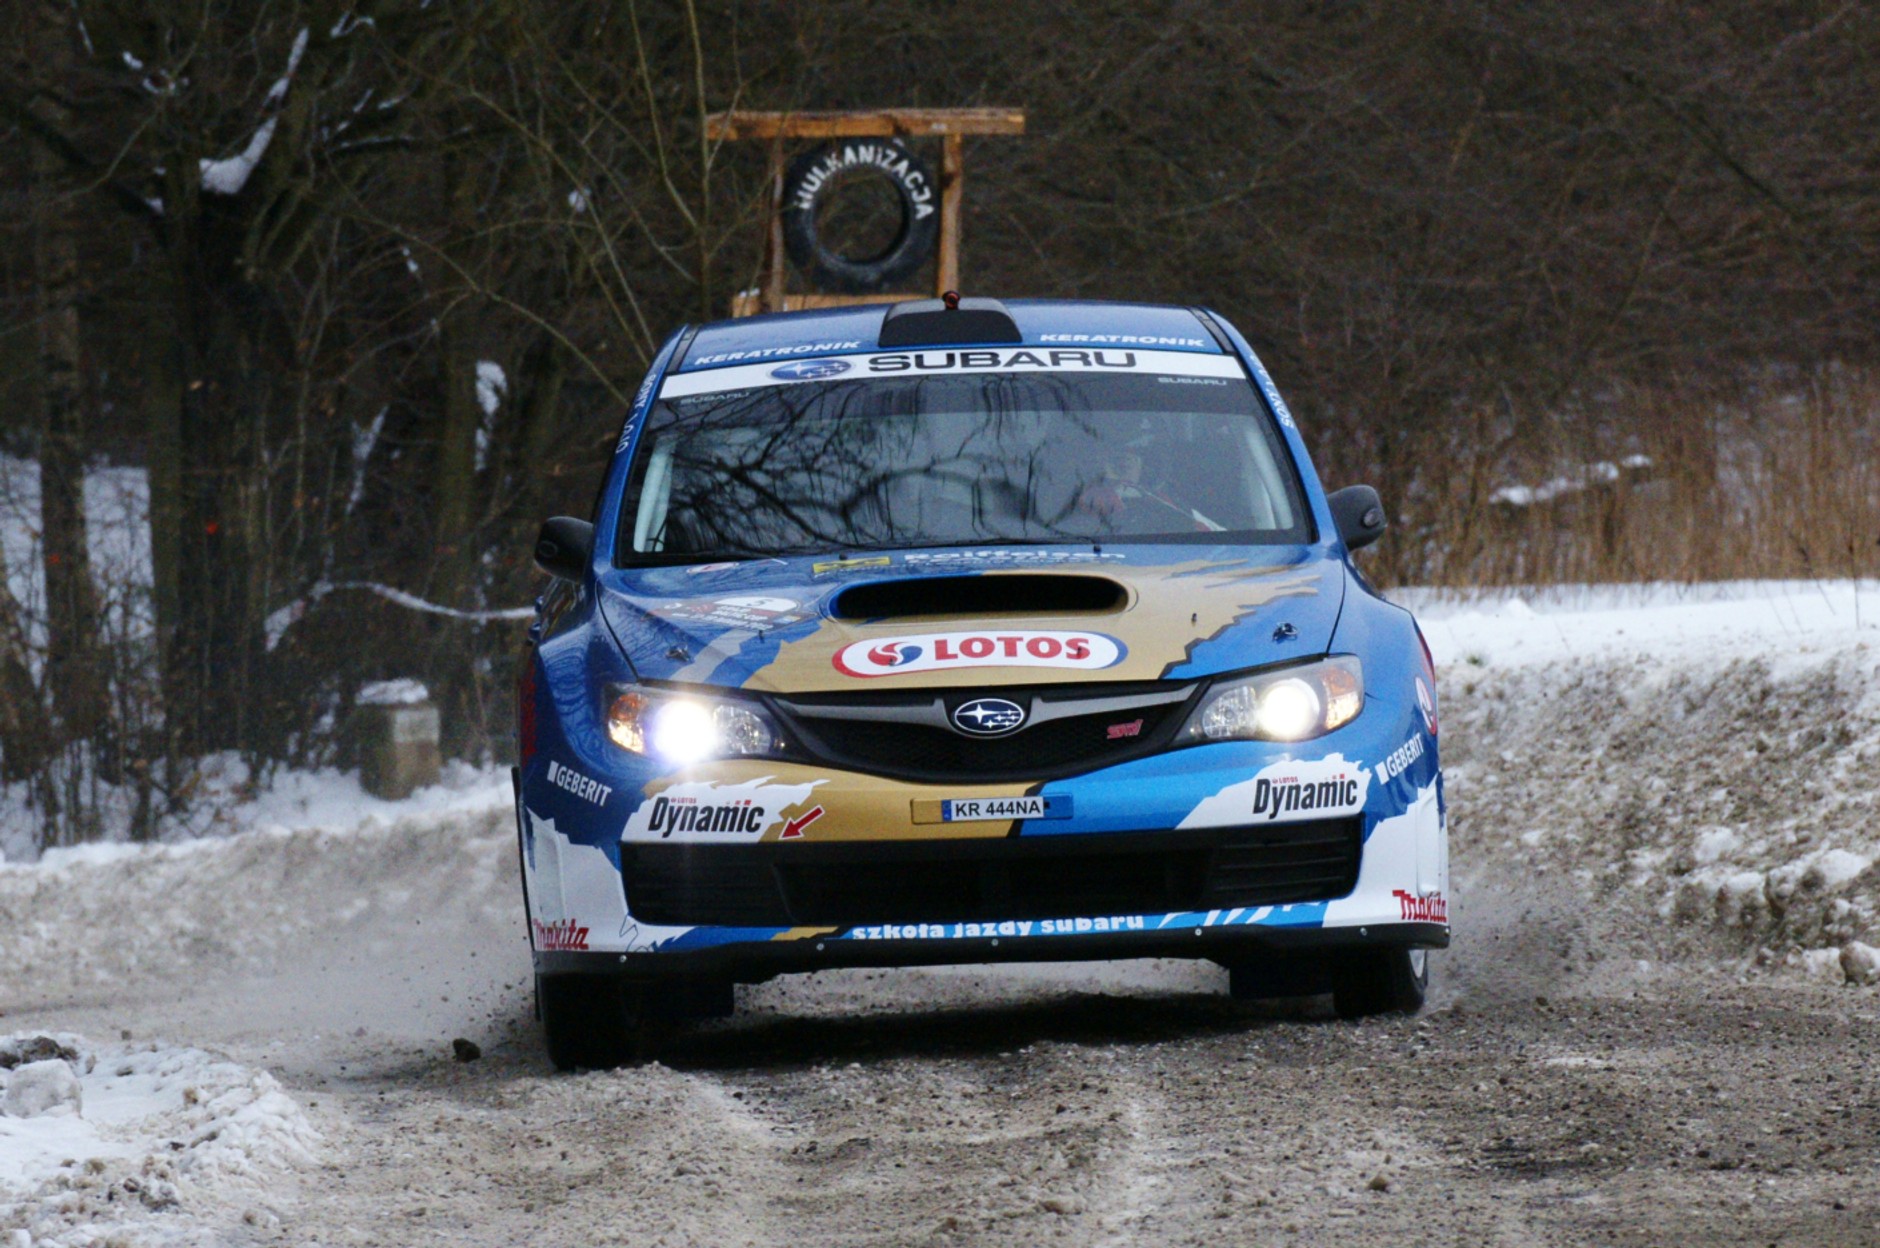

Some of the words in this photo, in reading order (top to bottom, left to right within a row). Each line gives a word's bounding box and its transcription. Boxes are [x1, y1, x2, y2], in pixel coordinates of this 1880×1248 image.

[1040, 334, 1204, 347] KERATRONIK
[694, 341, 861, 365] KERATRONIK
[868, 350, 1137, 372] SUBARU
[1157, 376, 1227, 386] SUBARU
[934, 636, 1090, 660] LOTOS
[1386, 732, 1425, 779] GEBERIT
[556, 763, 613, 807] GEBERIT
[1252, 773, 1358, 820] Dynamic
[648, 797, 765, 839] Dynamic
[955, 803, 981, 818] KR
[985, 800, 1042, 816] 444NA
[953, 921, 1034, 939] jazdy
[1040, 915, 1145, 933] subaru
